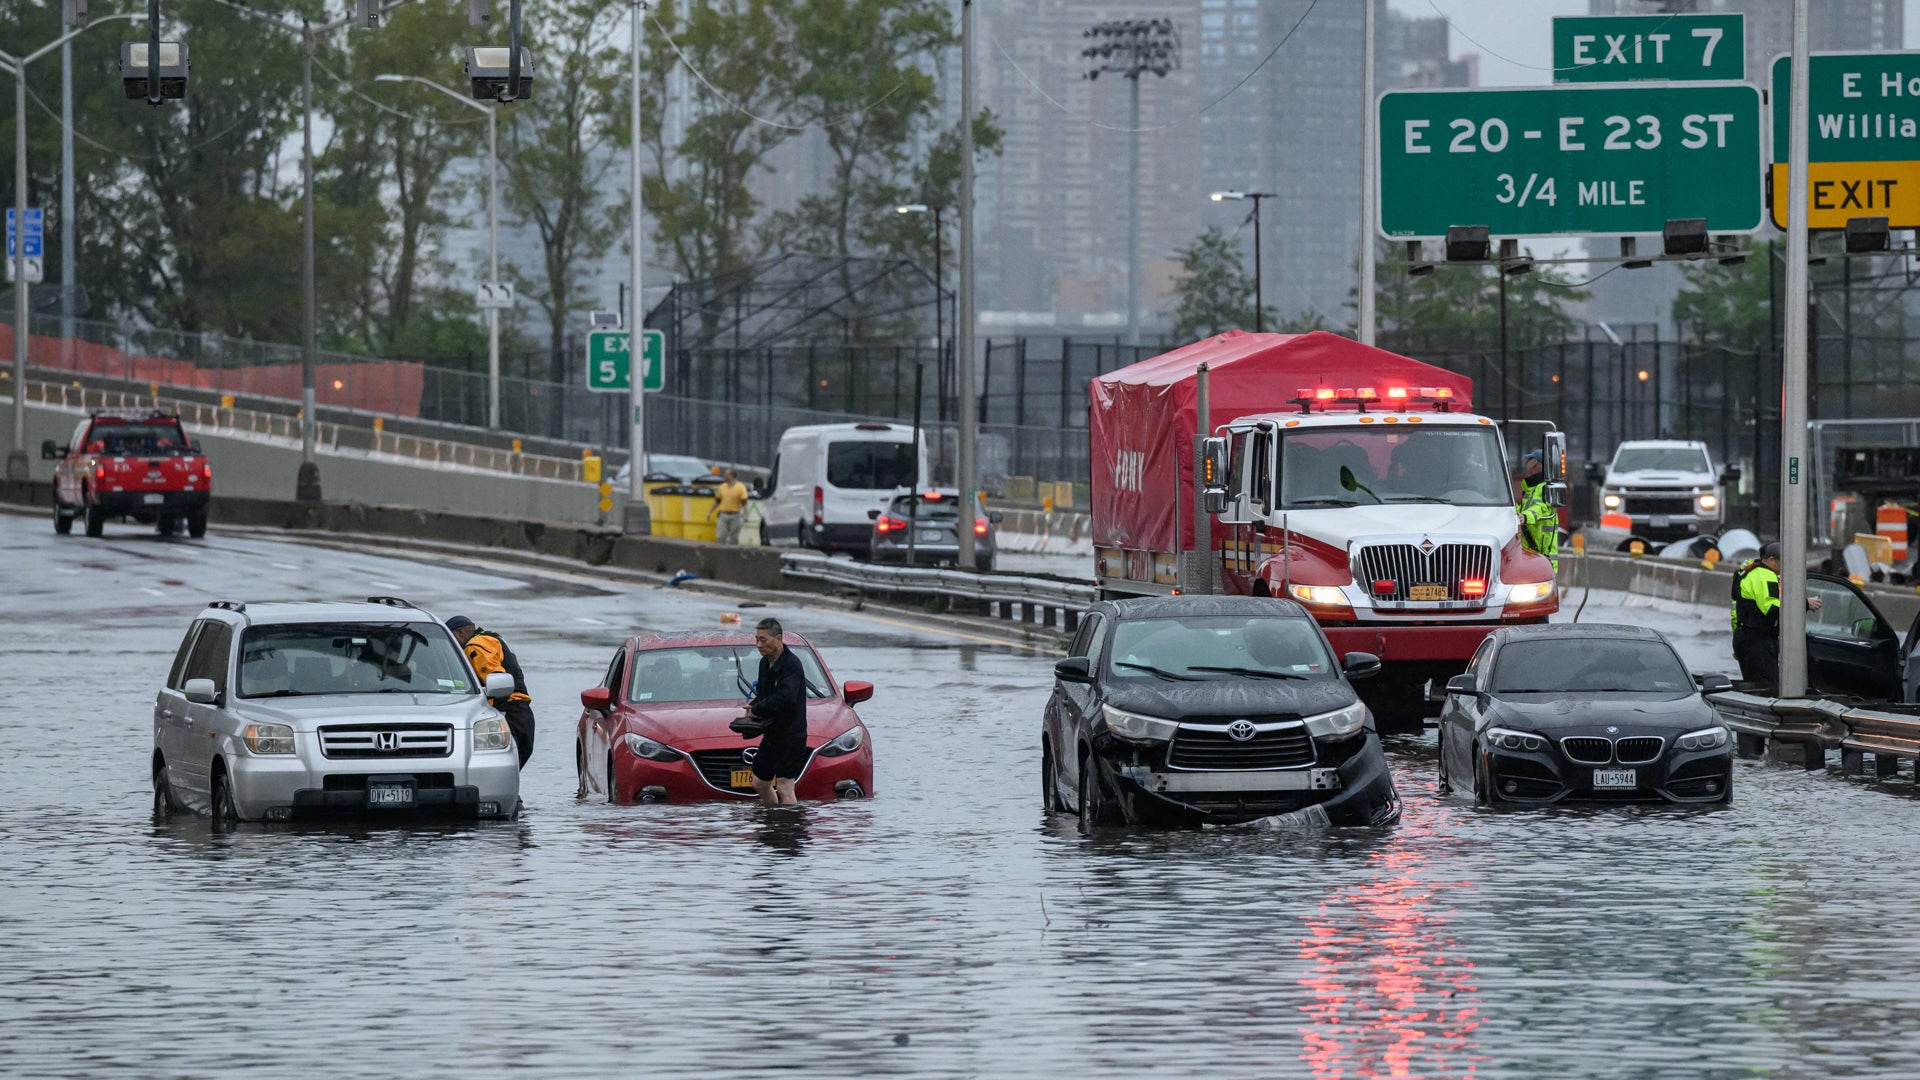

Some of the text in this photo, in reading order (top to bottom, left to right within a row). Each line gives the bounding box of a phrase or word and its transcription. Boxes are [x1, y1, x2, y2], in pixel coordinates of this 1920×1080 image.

[1573, 28, 1723, 67] EXIT 7
[1842, 73, 1862, 98] E
[1405, 120, 1431, 153] E
[1448, 118, 1509, 153] 20
[1559, 117, 1585, 151] E
[1603, 115, 1662, 150] 23
[1680, 114, 1734, 149] ST
[1817, 113, 1917, 139] Willia
[1495, 173, 1645, 208] 3/4 MILE
[1813, 180, 1898, 210] EXIT
[603, 337, 653, 353] EXT
[599, 360, 617, 383] 5
[1115, 449, 1145, 493] FDNY
